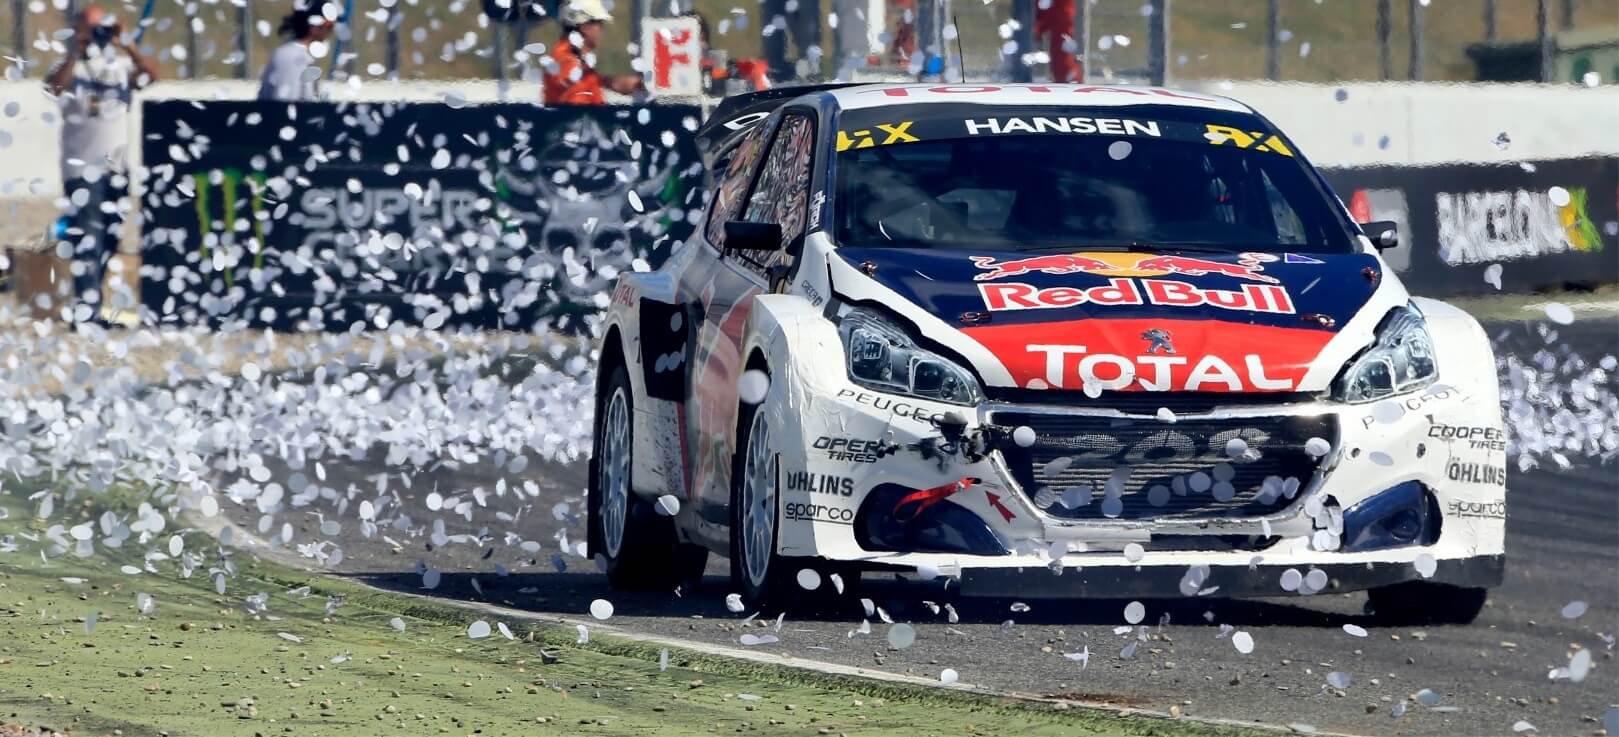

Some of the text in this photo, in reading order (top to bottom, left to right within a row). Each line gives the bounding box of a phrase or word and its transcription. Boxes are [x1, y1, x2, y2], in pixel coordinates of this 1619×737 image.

[654, 29, 690, 88] F
[857, 83, 1216, 101] TOTAL
[964, 116, 1161, 137] HANSEN
[301, 186, 481, 230] SUPER
[978, 279, 1297, 314] Red Bull
[1026, 343, 1293, 392] TOTAL
[1428, 425, 1504, 441] COOPER
[827, 450, 878, 463] TIRES
[785, 502, 854, 523] sparco
[1447, 501, 1506, 518] sparco
